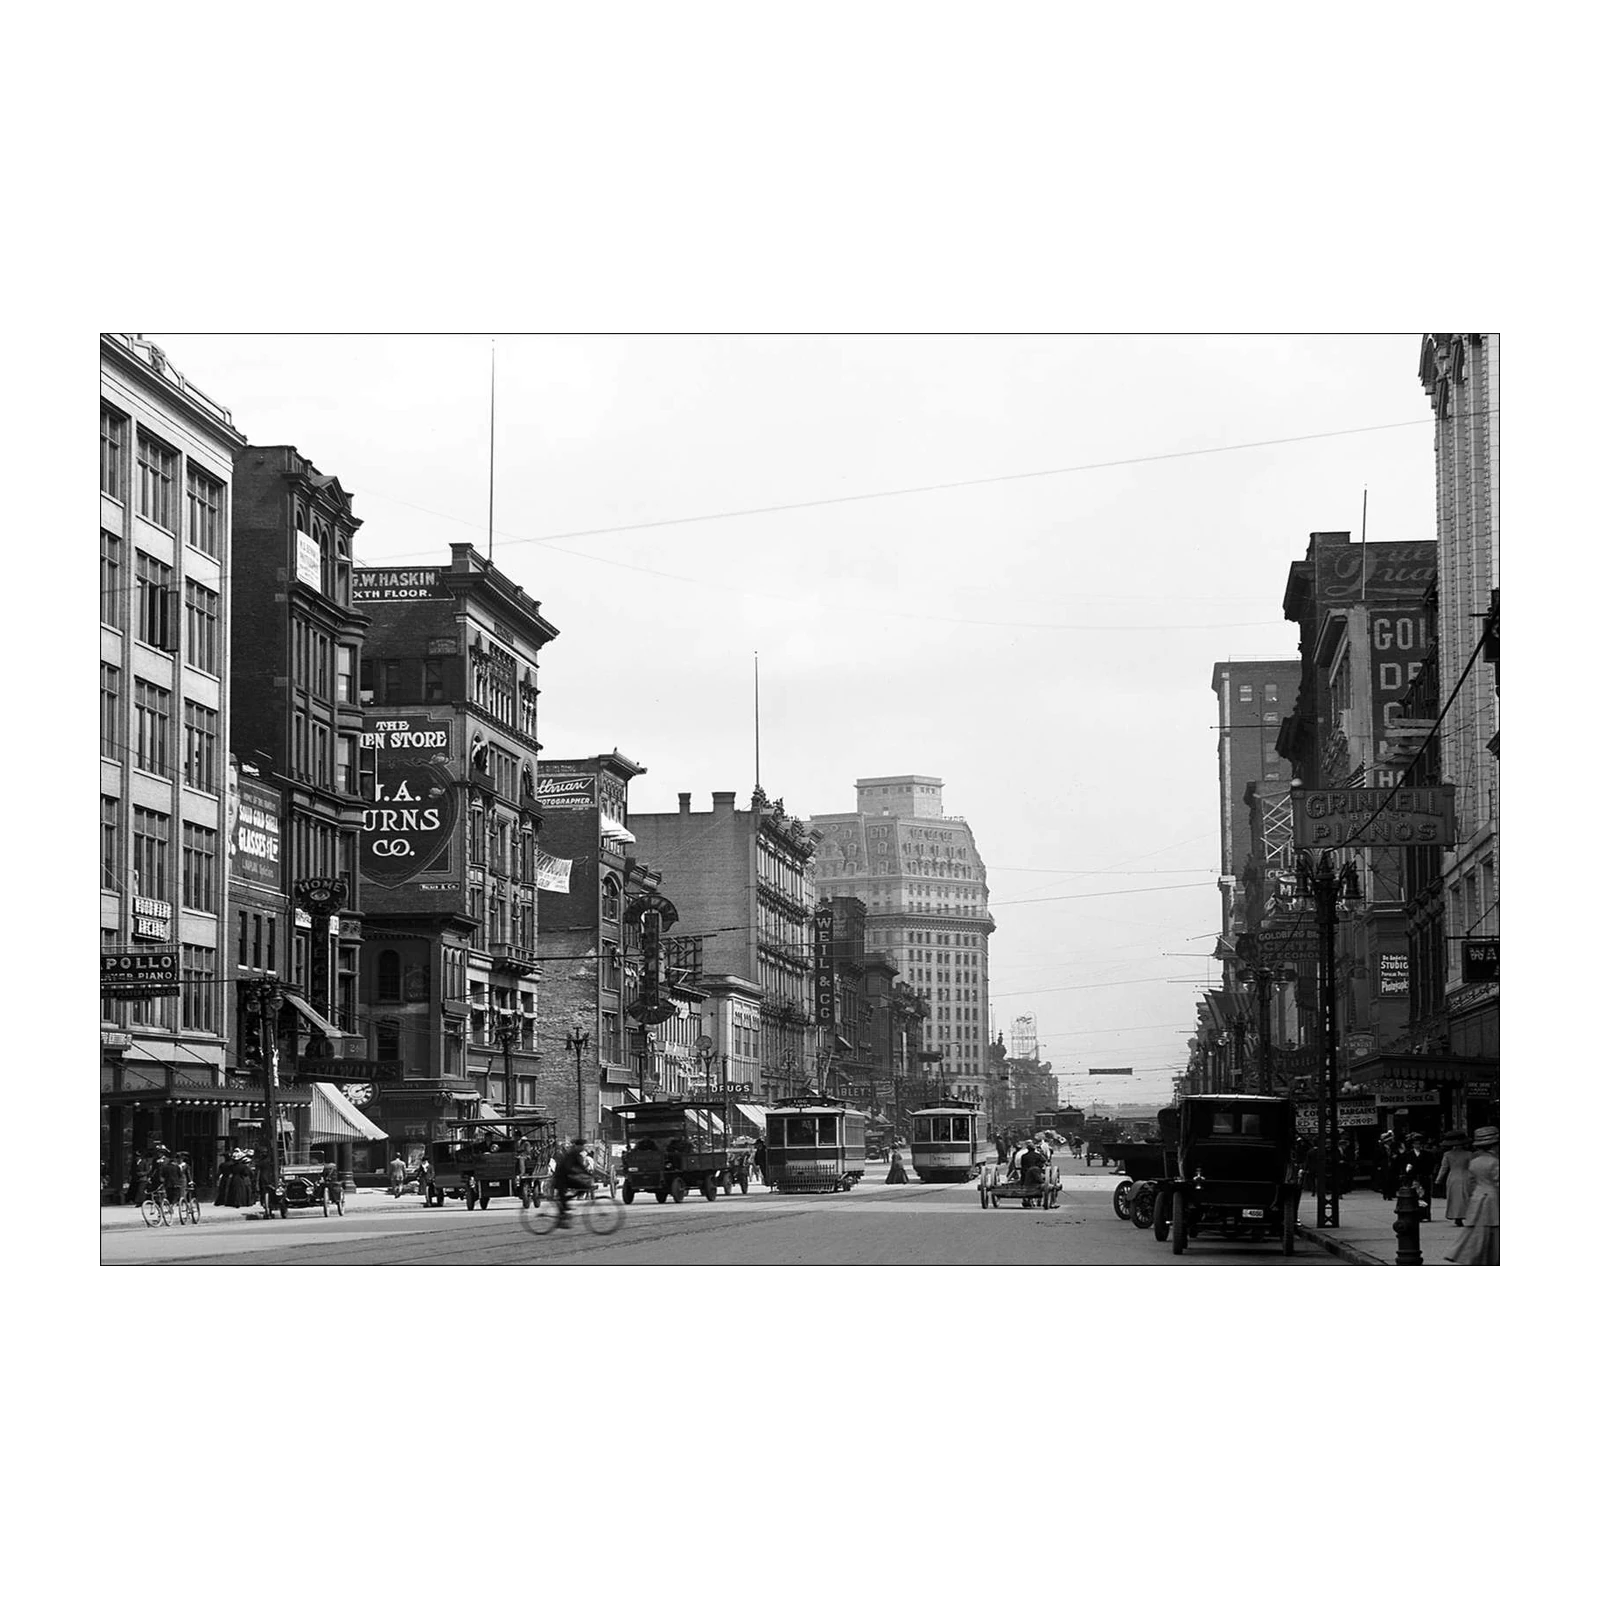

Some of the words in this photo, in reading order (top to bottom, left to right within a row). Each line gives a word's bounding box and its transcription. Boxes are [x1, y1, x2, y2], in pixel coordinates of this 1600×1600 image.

[384, 589, 432, 598] FLOOR.
[376, 720, 409, 731] THE
[390, 731, 447, 748] STORE
[1305, 791, 1443, 819] GRINNELL
[1311, 822, 1438, 843] PIANOS
[238, 826, 267, 859] GLASSES
[372, 838, 415, 857] CO.
[298, 879, 343, 893] HOME
[817, 917, 832, 969] WEIL
[100, 956, 172, 970] POLLO
[138, 971, 173, 981] PIANO
